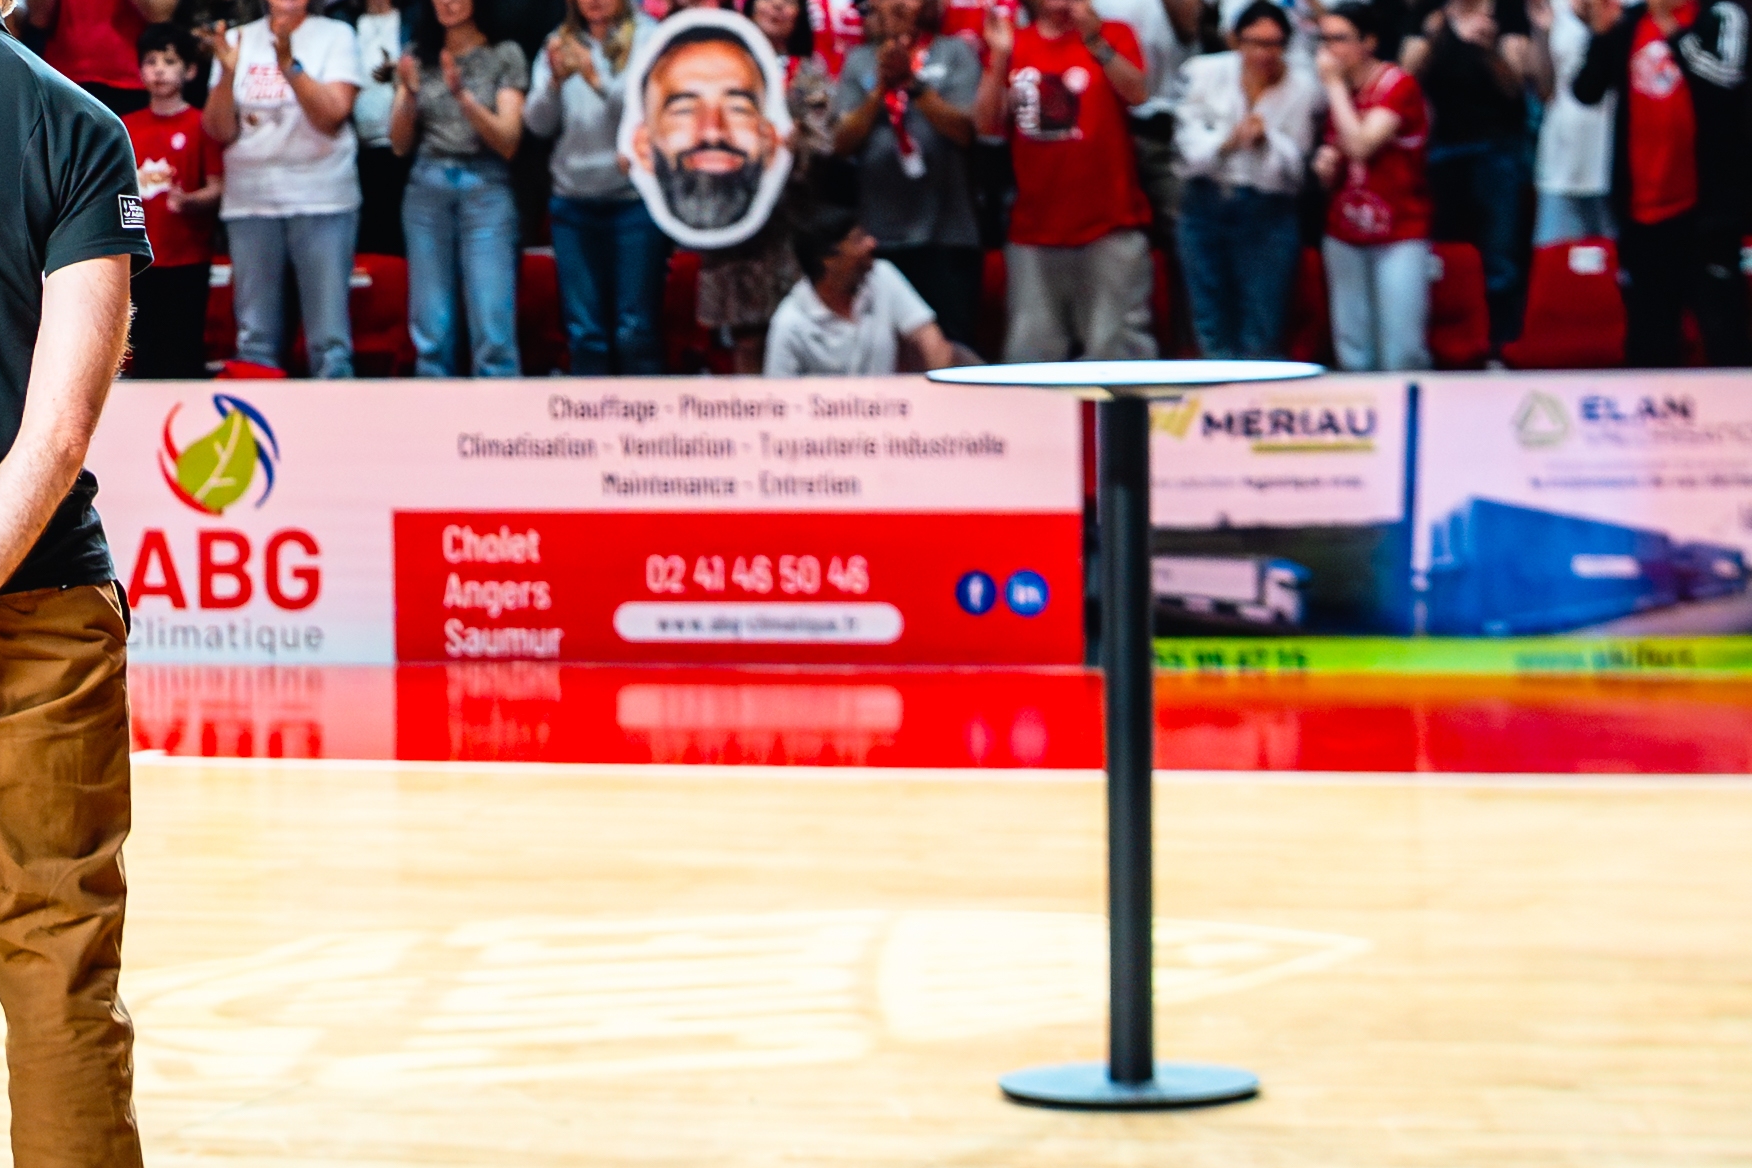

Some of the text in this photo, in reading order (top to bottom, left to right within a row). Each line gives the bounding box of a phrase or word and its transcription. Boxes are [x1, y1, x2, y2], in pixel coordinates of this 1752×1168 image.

[547, 394, 659, 424] Chauffage
[808, 393, 910, 420] Sanitaire
[456, 432, 598, 460] Climatisation
[619, 432, 736, 459] Ventilation
[601, 469, 862, 497] Maintenance Entretien
[442, 523, 541, 564] Cholet
[127, 527, 323, 612] ABG
[645, 553, 686, 594] 02
[693, 554, 726, 594] 41
[779, 554, 821, 595] 50
[442, 573, 552, 617] Angers
[443, 618, 564, 658] Saumur
